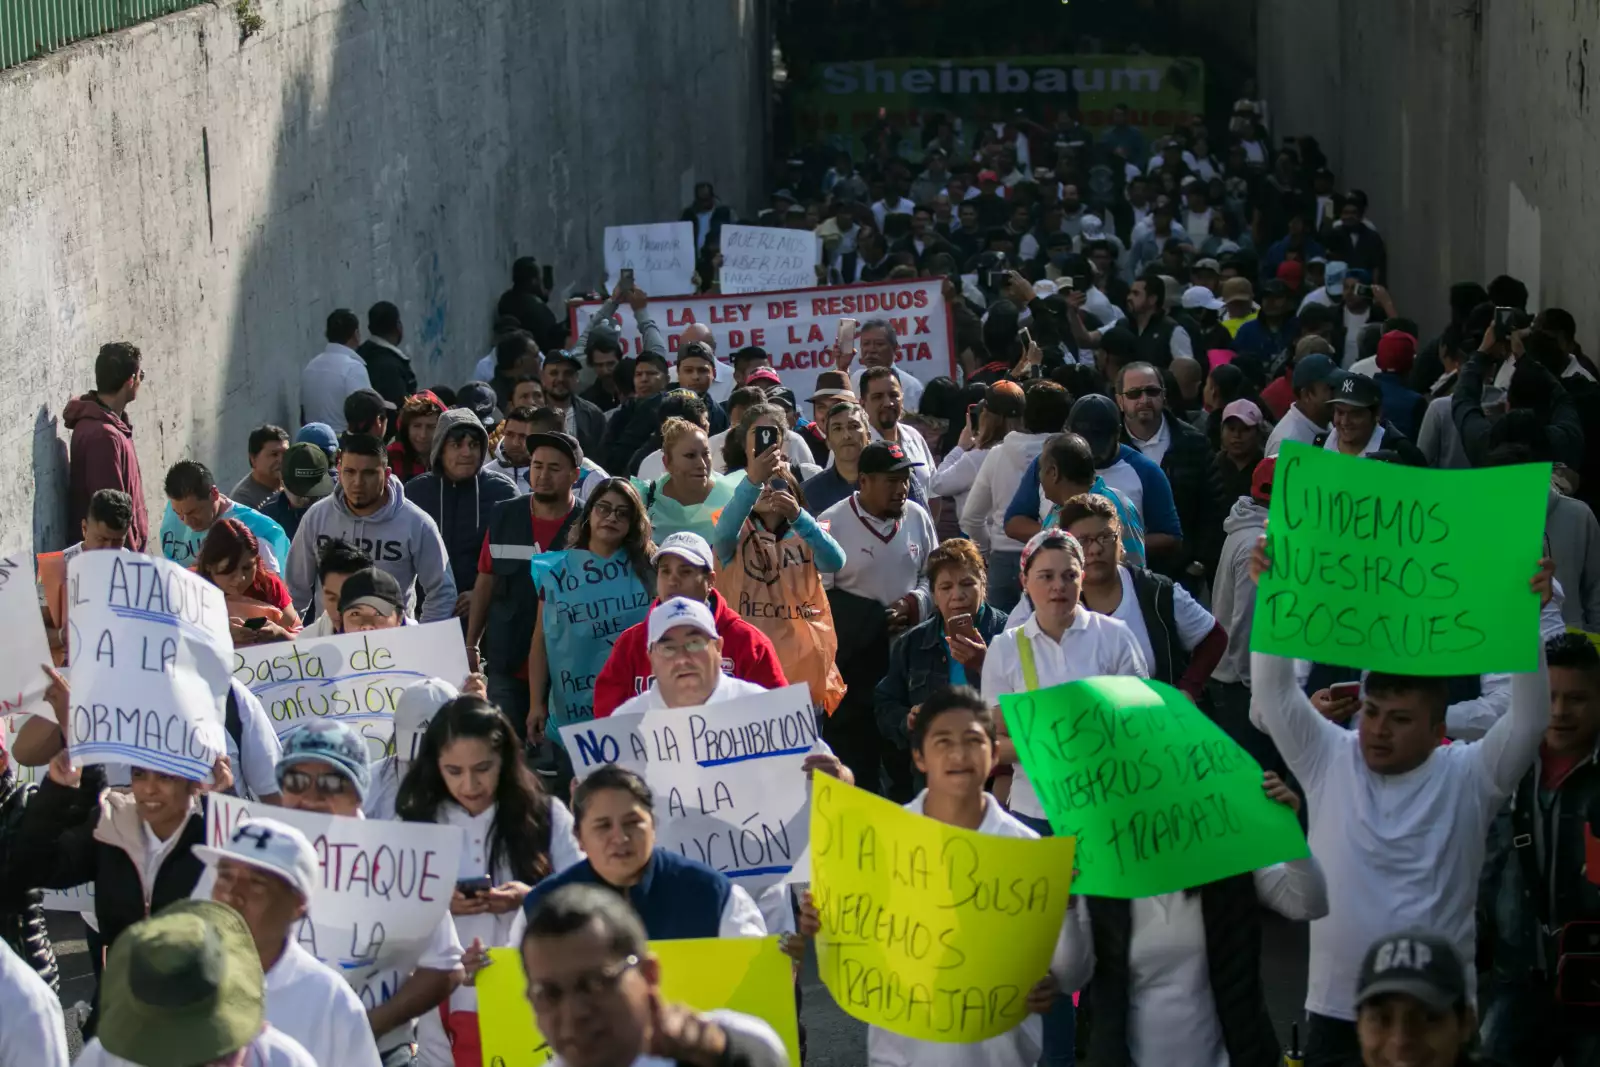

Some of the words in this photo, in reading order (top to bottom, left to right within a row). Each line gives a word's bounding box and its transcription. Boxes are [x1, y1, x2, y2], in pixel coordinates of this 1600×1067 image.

[822, 60, 1163, 95] Sheinbaum
[667, 307, 697, 327] LA
[709, 303, 752, 324] LEY
[767, 301, 799, 320] DE
[812, 289, 929, 316] RESIDUOS
[729, 328, 766, 348] DE
[787, 323, 825, 344] LA
[317, 534, 402, 561] PRIS
[1267, 534, 1460, 599] NUESTROS
[583, 558, 629, 584] SOY
[108, 556, 214, 633] ATAQUE
[557, 592, 650, 624] REUTILIZ
[1266, 590, 1486, 658] BOSQUES
[96, 629, 114, 668] A
[141, 635, 178, 679] LA
[350, 635, 396, 671] de
[561, 669, 597, 694] REC
[574, 728, 620, 767] NO
[630, 732, 648, 762] A
[653, 725, 681, 763] LA
[669, 786, 686, 817] A
[698, 780, 734, 815] LA
[313, 833, 440, 902] ATAQUE
[816, 785, 844, 858] SI
[858, 825, 876, 872] A
[893, 840, 932, 890] LA
[936, 836, 1050, 916] BOLSA
[351, 921, 386, 960] LA
[1373, 938, 1433, 974] GAP
[821, 941, 1020, 1033] TRABAJAR
